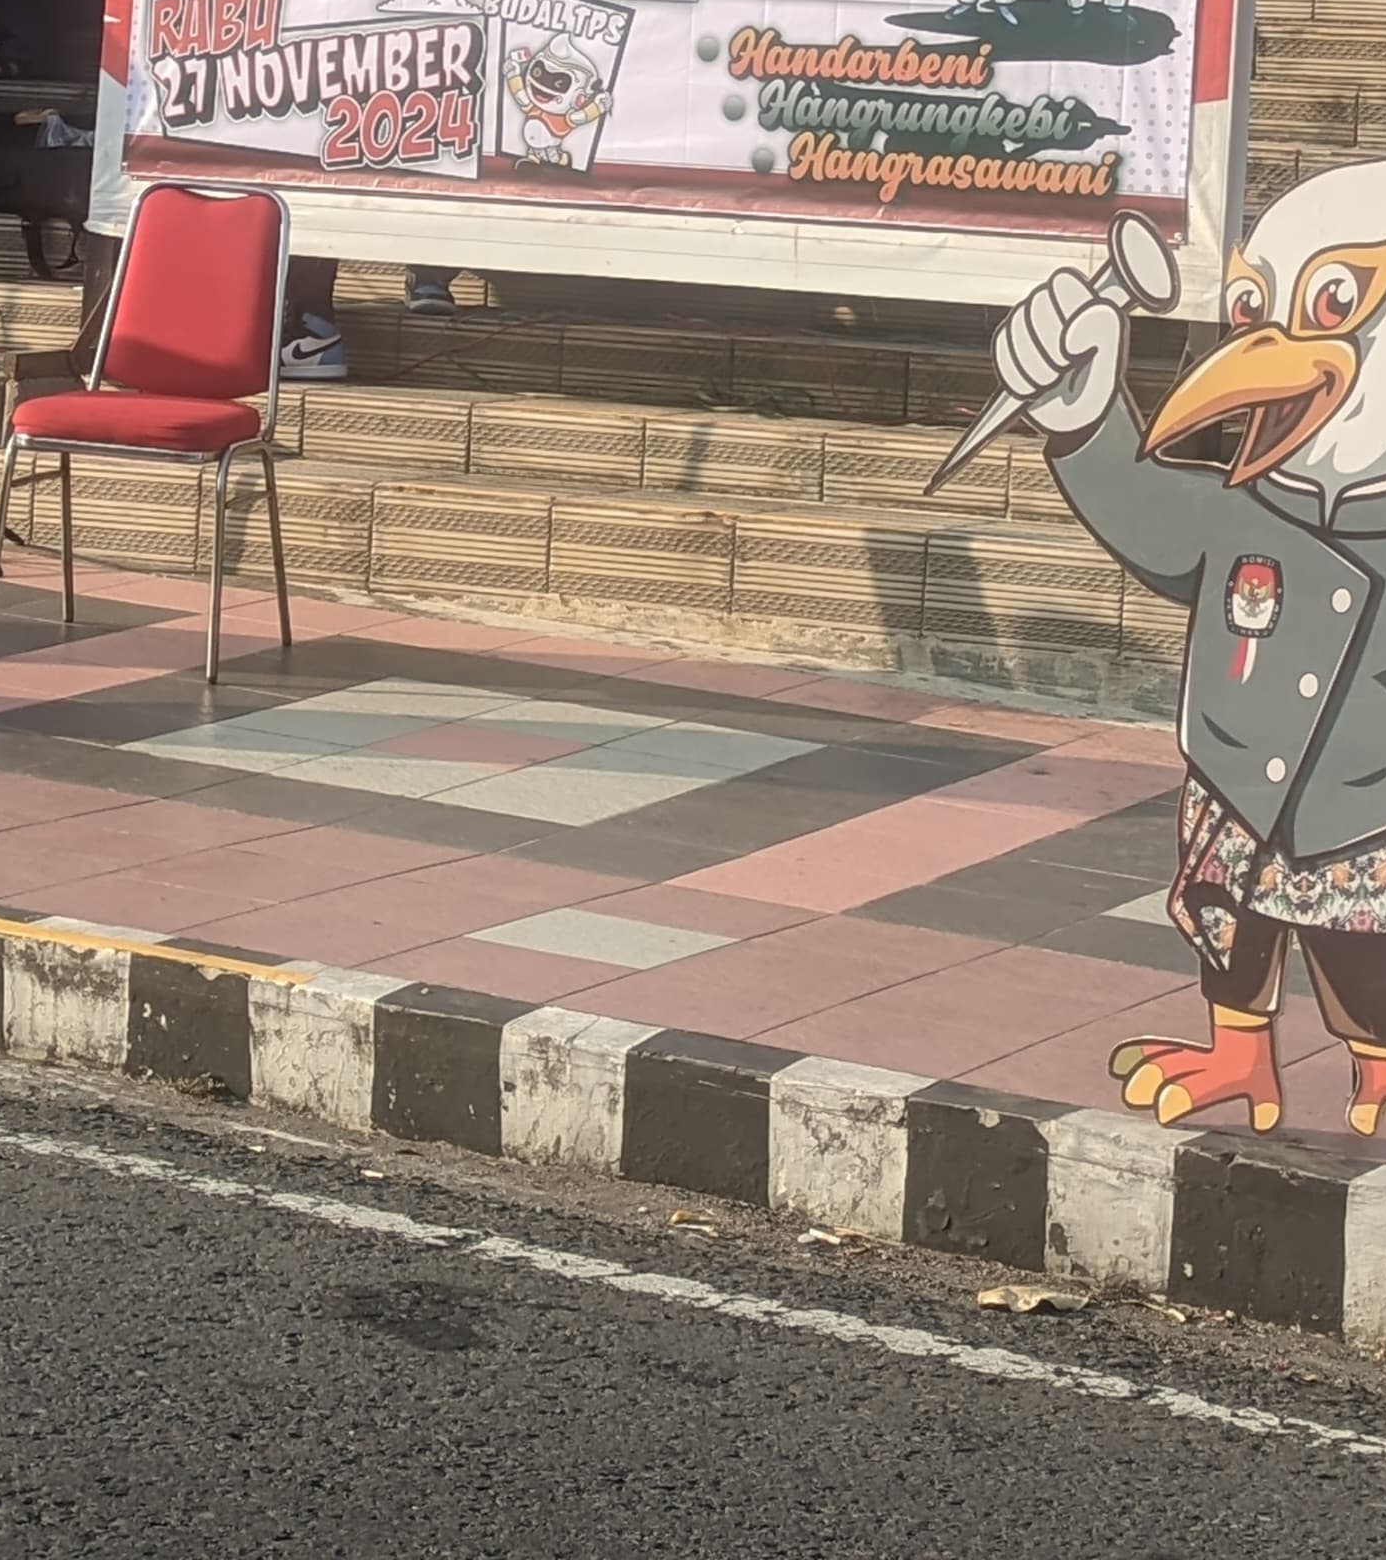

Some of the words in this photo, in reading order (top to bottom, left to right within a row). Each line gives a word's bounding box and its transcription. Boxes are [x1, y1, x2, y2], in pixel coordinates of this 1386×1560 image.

[573, 6, 627, 44] TPS
[730, 28, 993, 85] Handarbeni
[154, 55, 208, 118] 27
[220, 26, 472, 110] NOVEMBER
[323, 91, 474, 163] 2024
[760, 79, 1076, 146] Hangrungkebi
[790, 132, 1117, 202] Hangrasawani
